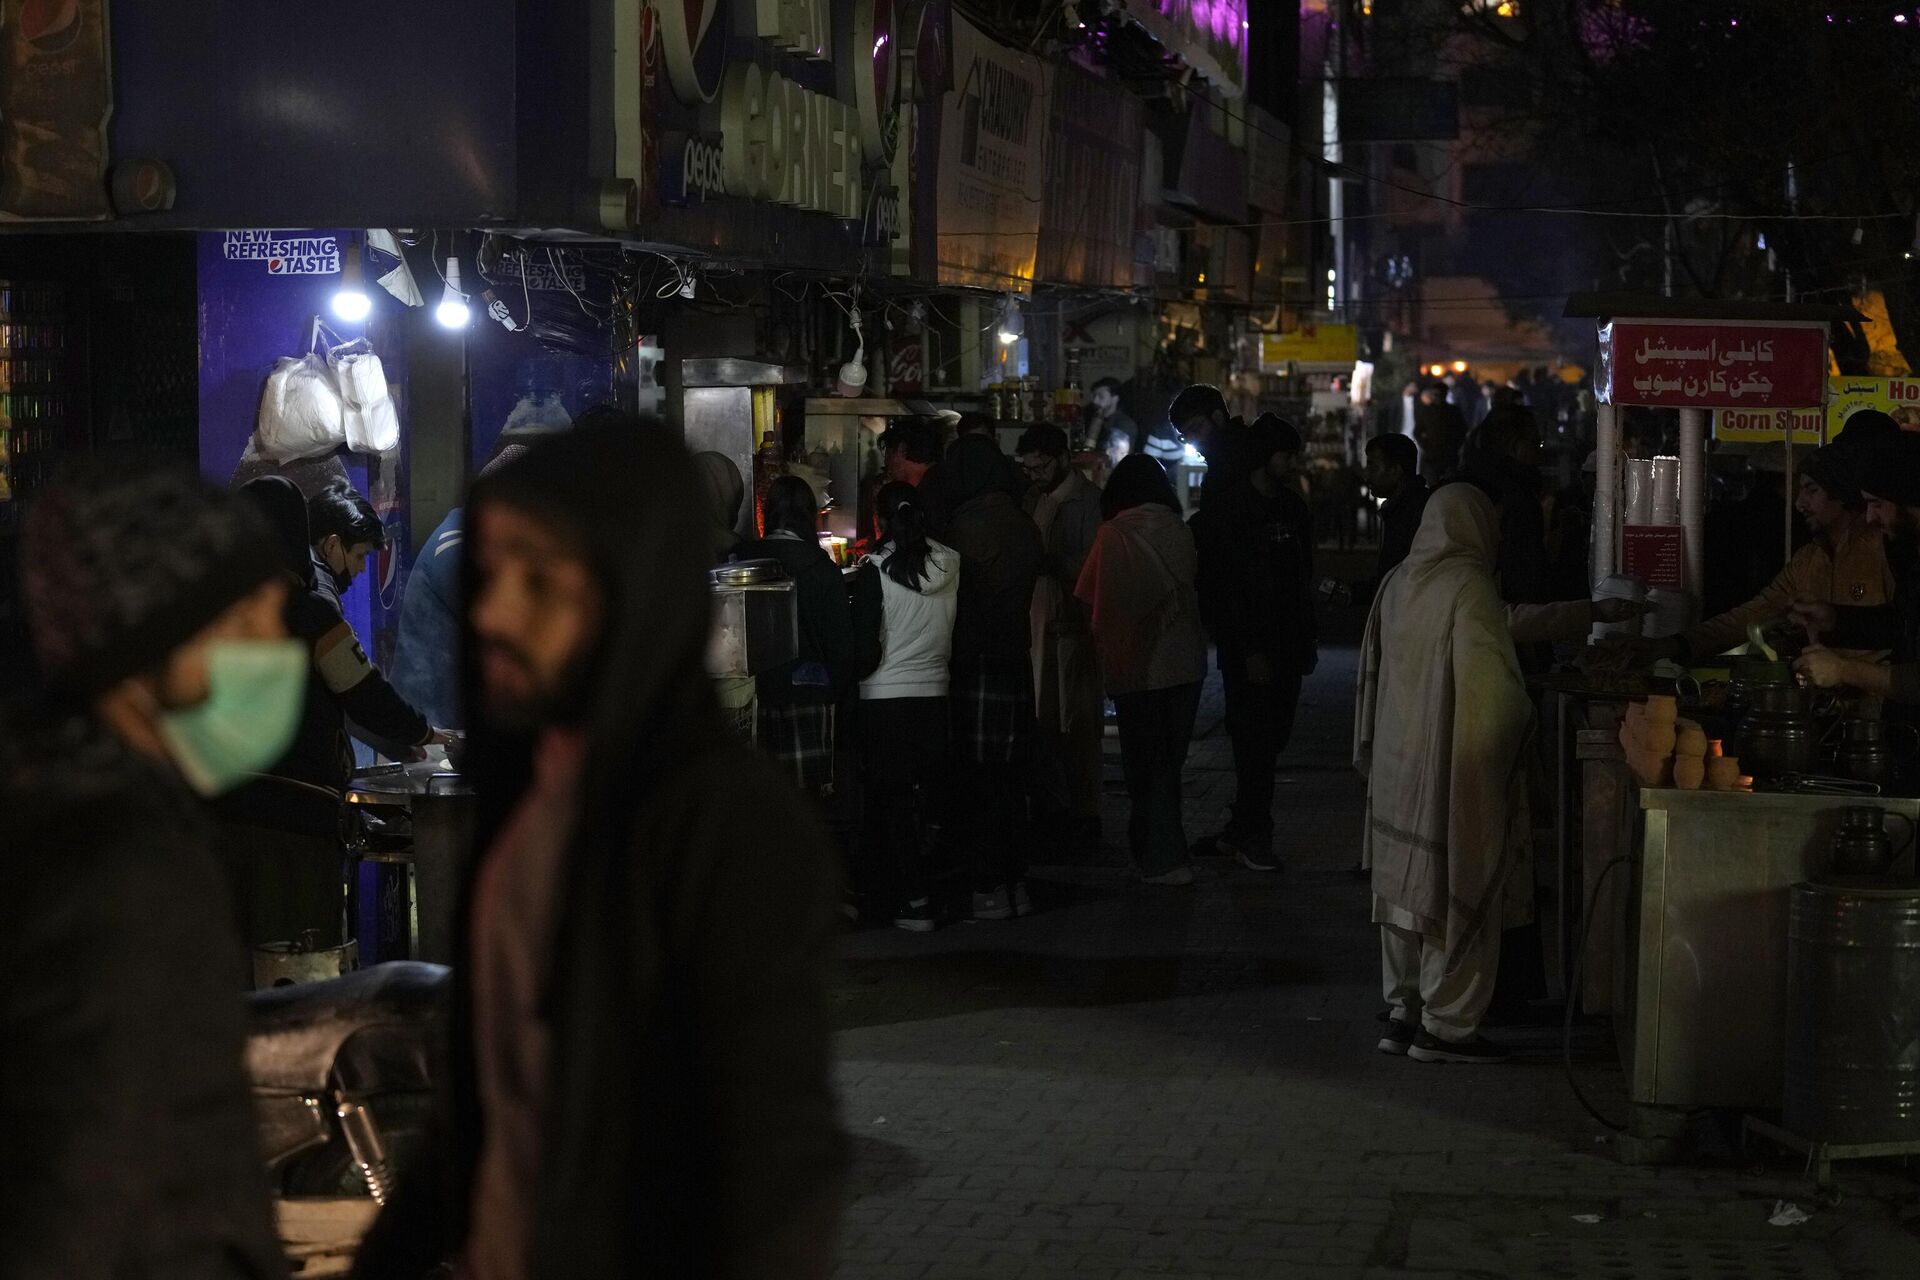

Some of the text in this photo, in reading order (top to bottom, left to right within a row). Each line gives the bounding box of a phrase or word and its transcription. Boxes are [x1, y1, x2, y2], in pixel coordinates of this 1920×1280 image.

[738, 62, 861, 220] CORNER
[876, 195, 897, 243] peps
[227, 239, 337, 259] REFRESHING
[228, 230, 271, 243] NEW
[284, 256, 335, 273] TASTE
[1634, 336, 1774, 369] کابلی اسپیشل
[1632, 370, 1774, 401] چکن کارن سوپ
[1722, 410, 1771, 430] Corn
